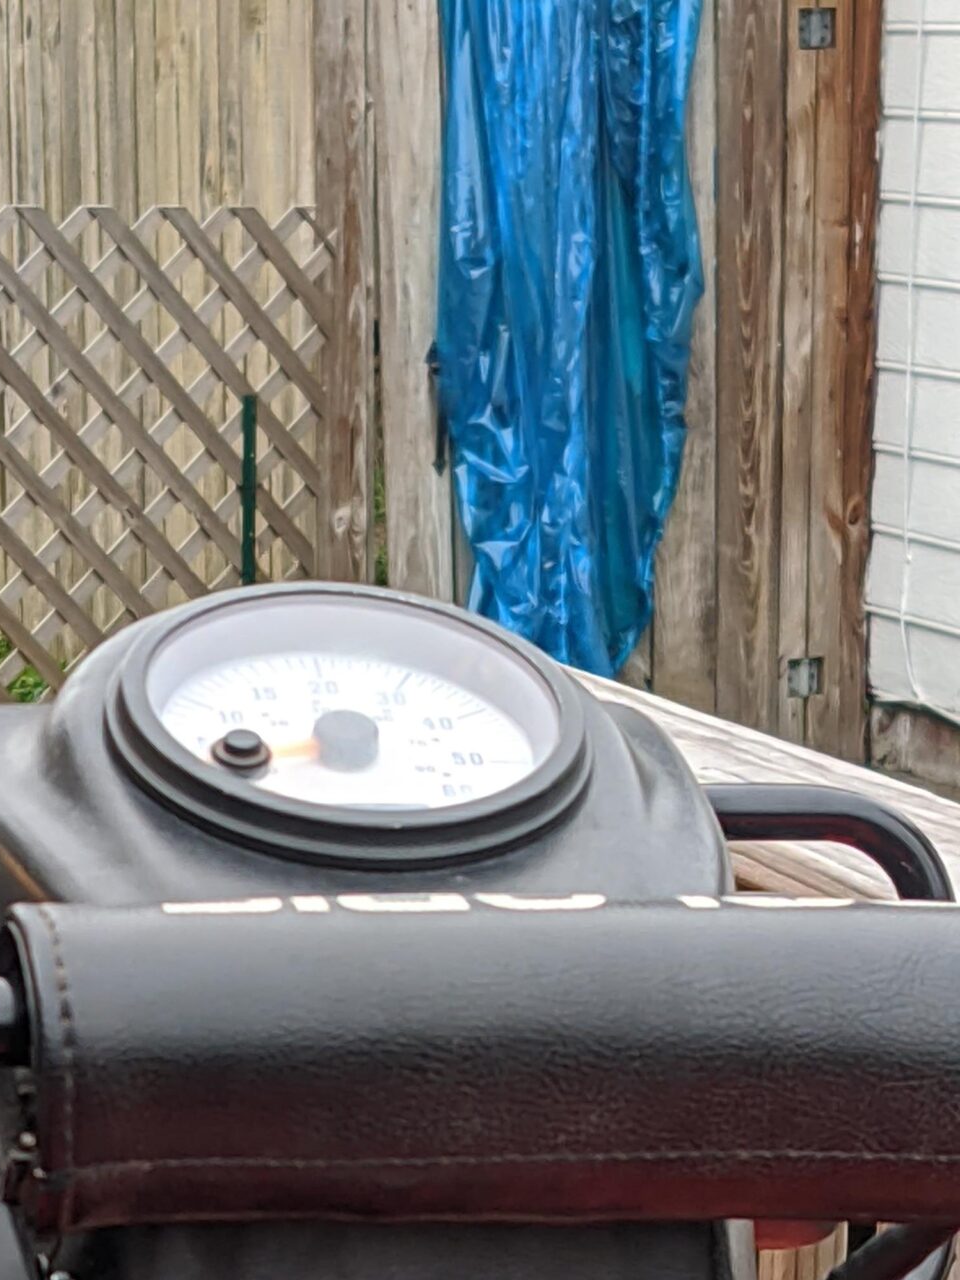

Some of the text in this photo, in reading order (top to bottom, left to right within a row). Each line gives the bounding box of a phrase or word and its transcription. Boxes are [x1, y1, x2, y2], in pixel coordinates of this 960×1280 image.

[252, 686, 277, 701] 15
[307, 680, 338, 695] 20
[377, 691, 407, 706] 30
[219, 709, 244, 724] 10
[422, 716, 453, 731] 40
[451, 751, 484, 766] 50
